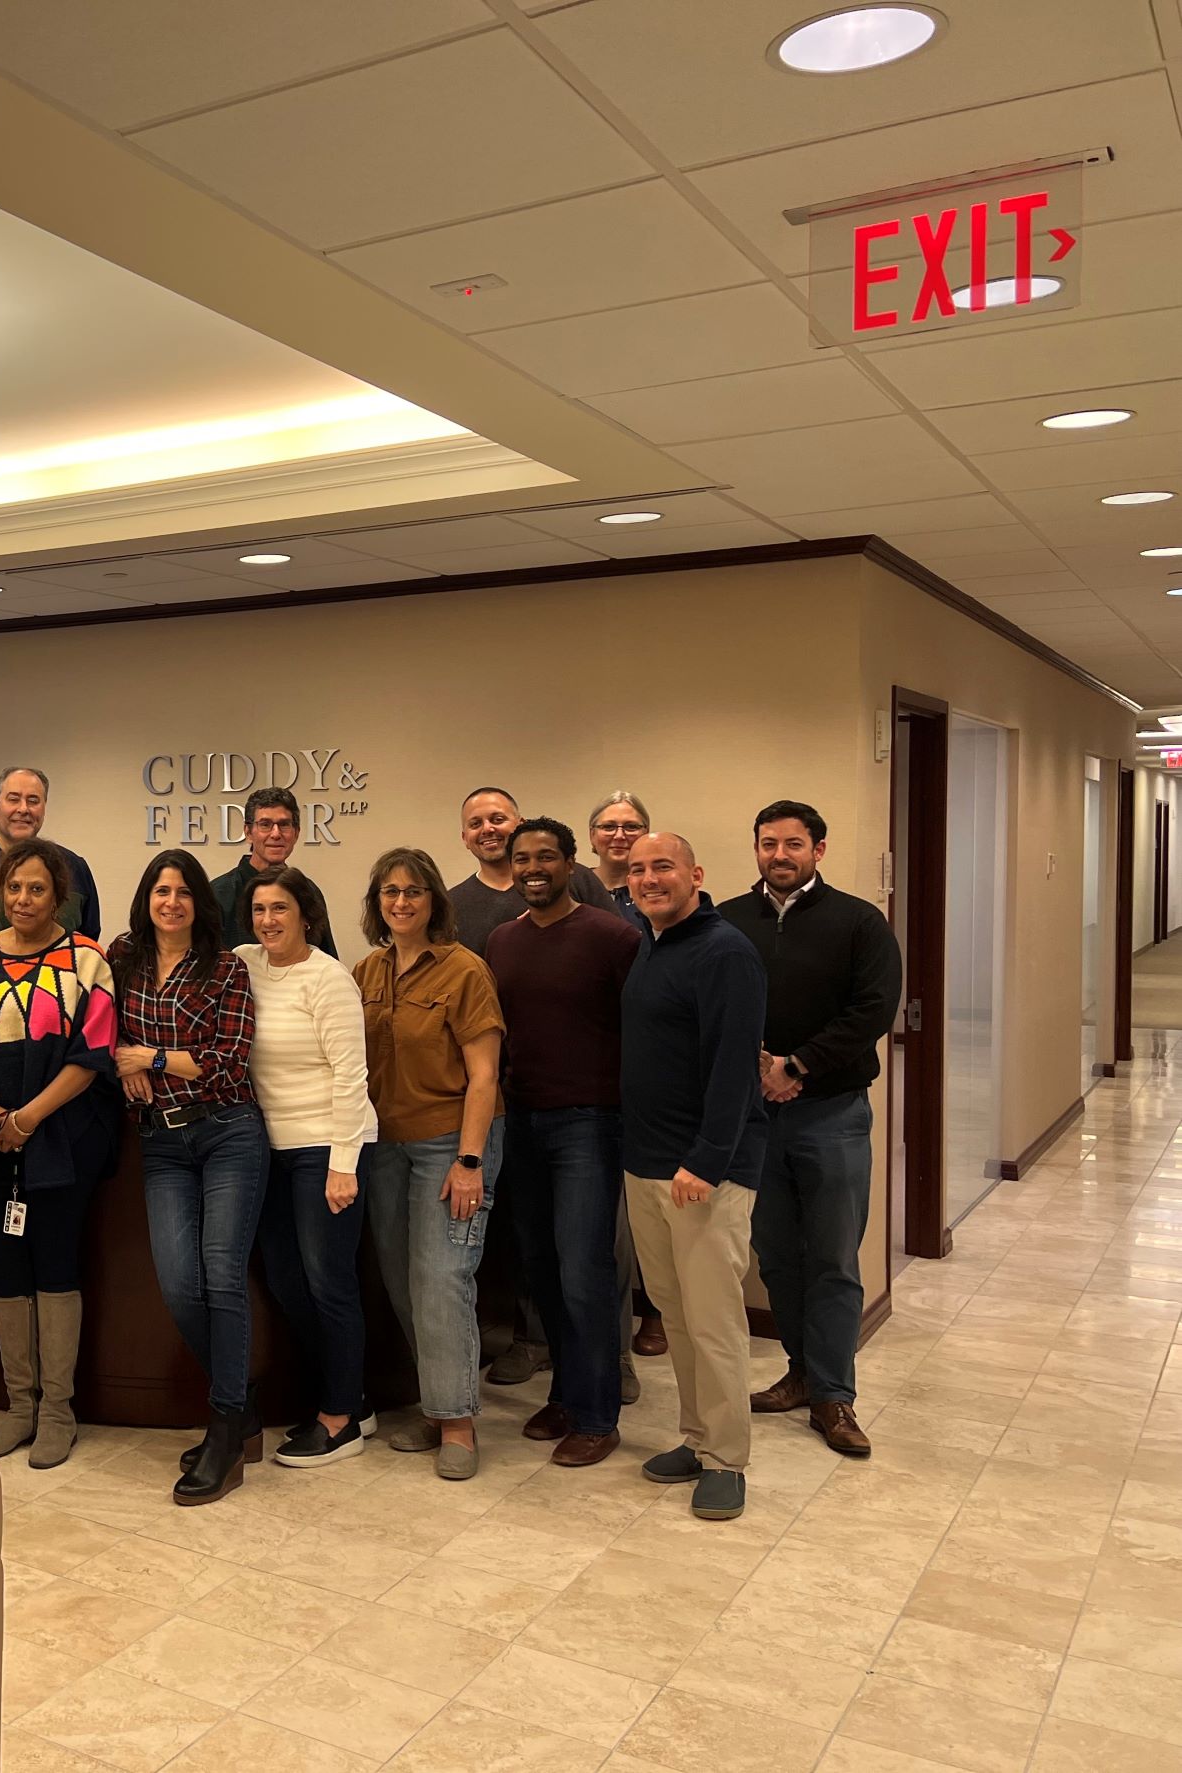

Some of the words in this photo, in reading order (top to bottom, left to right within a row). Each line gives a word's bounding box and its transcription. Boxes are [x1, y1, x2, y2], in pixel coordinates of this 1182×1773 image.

[853, 192, 1049, 332] EXIT
[144, 802, 341, 846] FEDR
[339, 800, 368, 817] LLP
